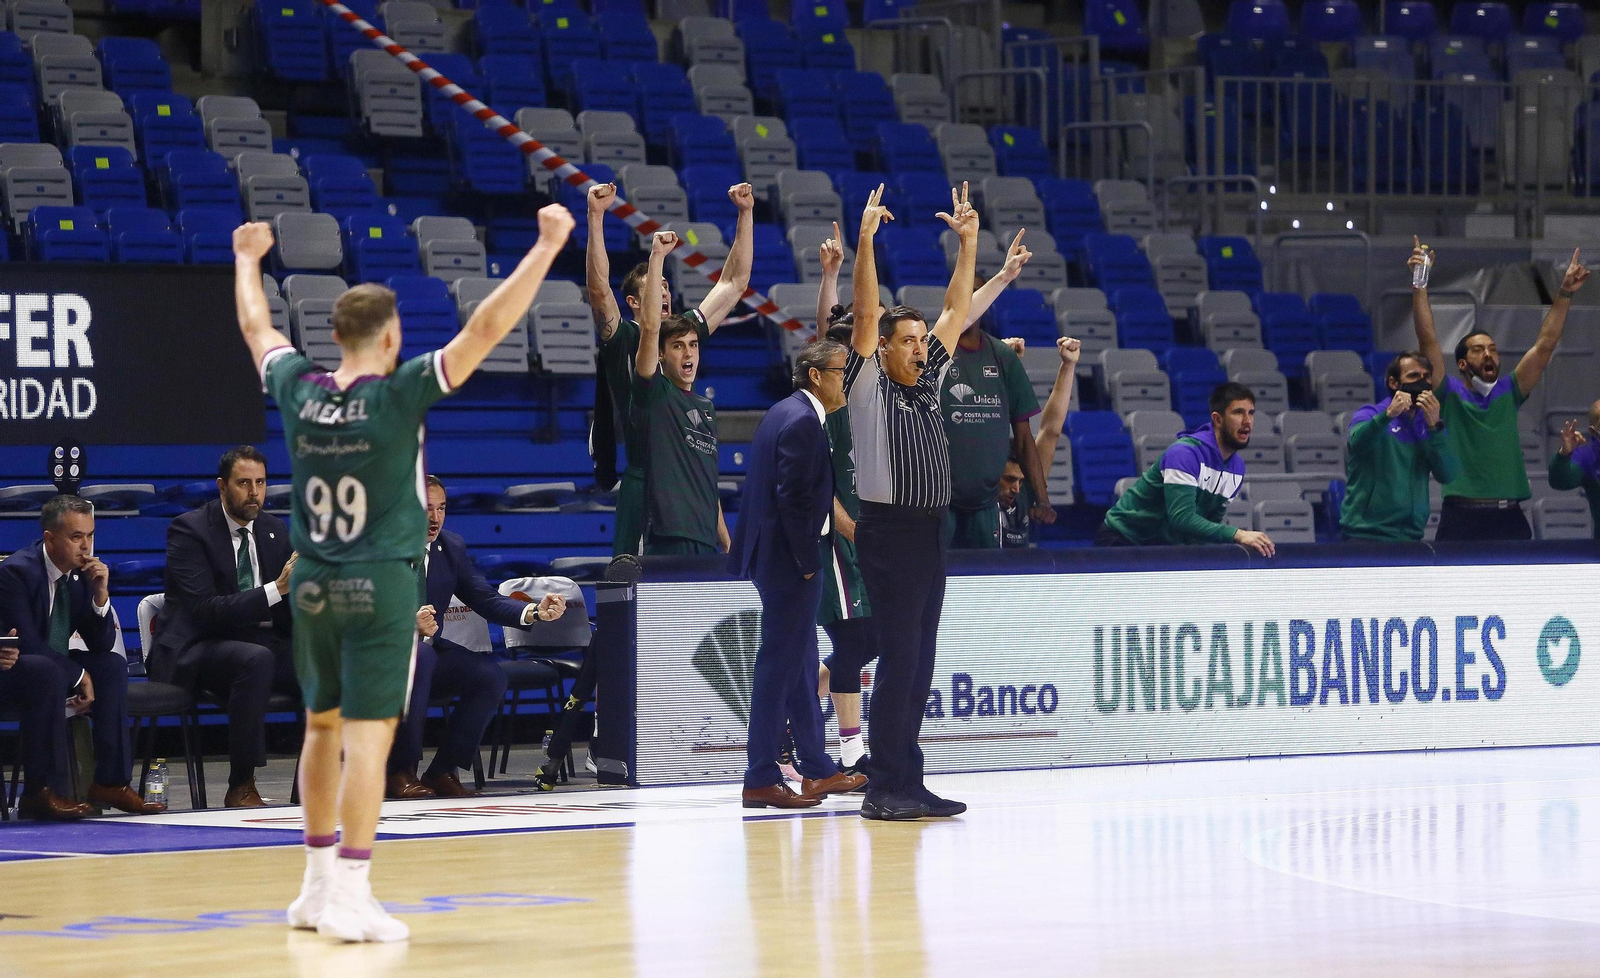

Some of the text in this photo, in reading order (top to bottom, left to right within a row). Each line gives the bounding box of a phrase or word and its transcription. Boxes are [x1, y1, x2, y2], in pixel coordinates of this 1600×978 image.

[973, 394, 1001, 407] Unicaja
[305, 475, 367, 543] 99
[1093, 615, 1507, 713] UNICAJABANCO.ES
[952, 672, 1059, 718] Banco
